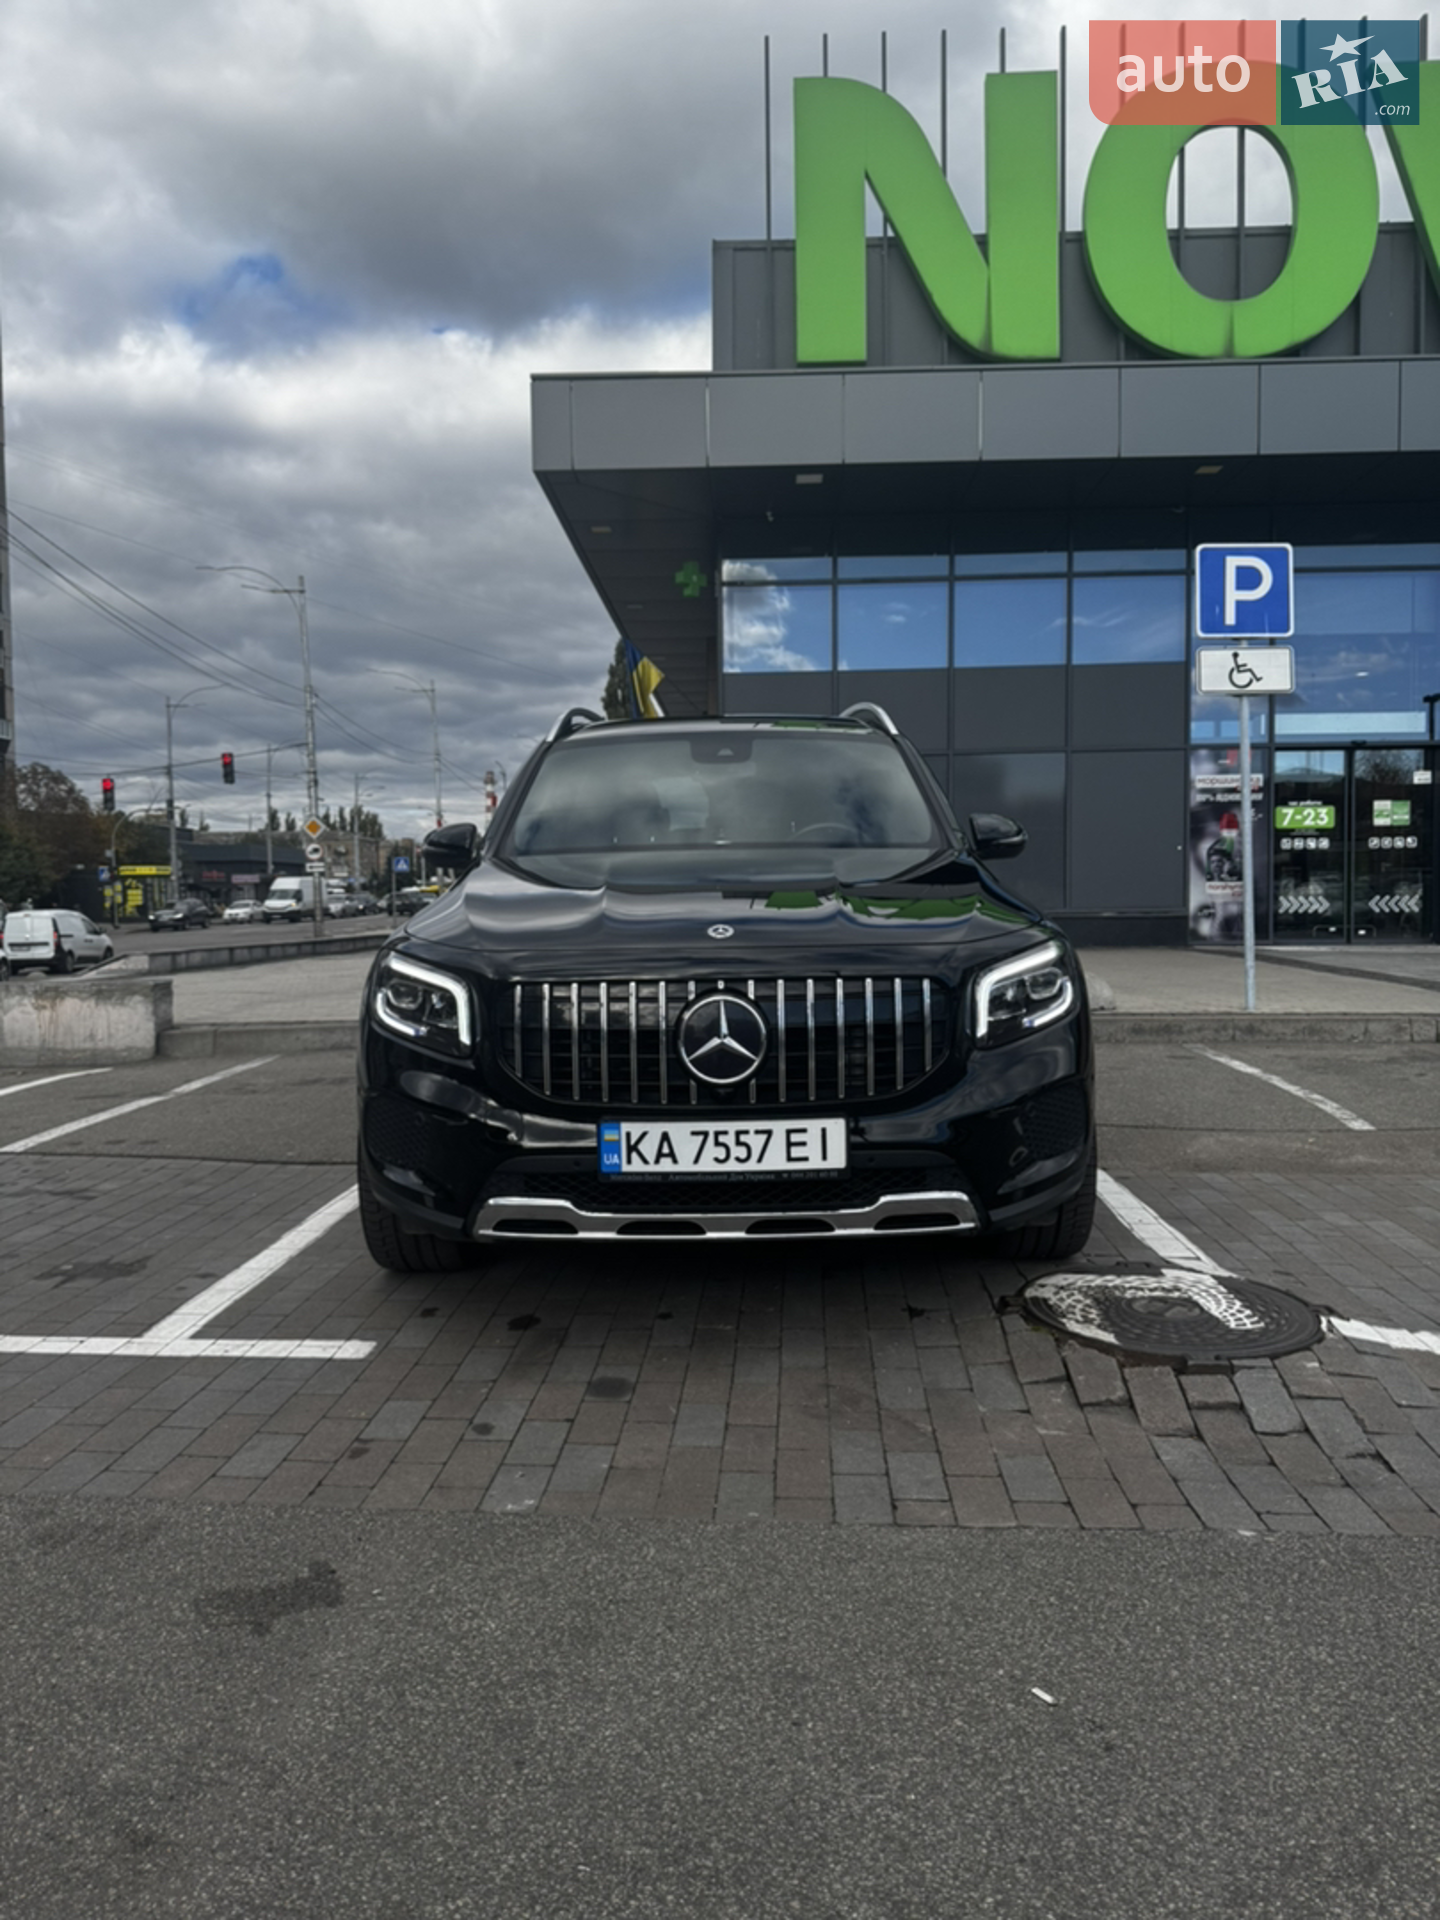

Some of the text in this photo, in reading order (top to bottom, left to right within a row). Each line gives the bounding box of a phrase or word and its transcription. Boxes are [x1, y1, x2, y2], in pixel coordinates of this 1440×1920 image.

[1224, 555, 1273, 626] P
[1281, 808, 1329, 827] 7-23
[604, 1153, 620, 1165] UA
[625, 1127, 827, 1166] KA 7557 EI
